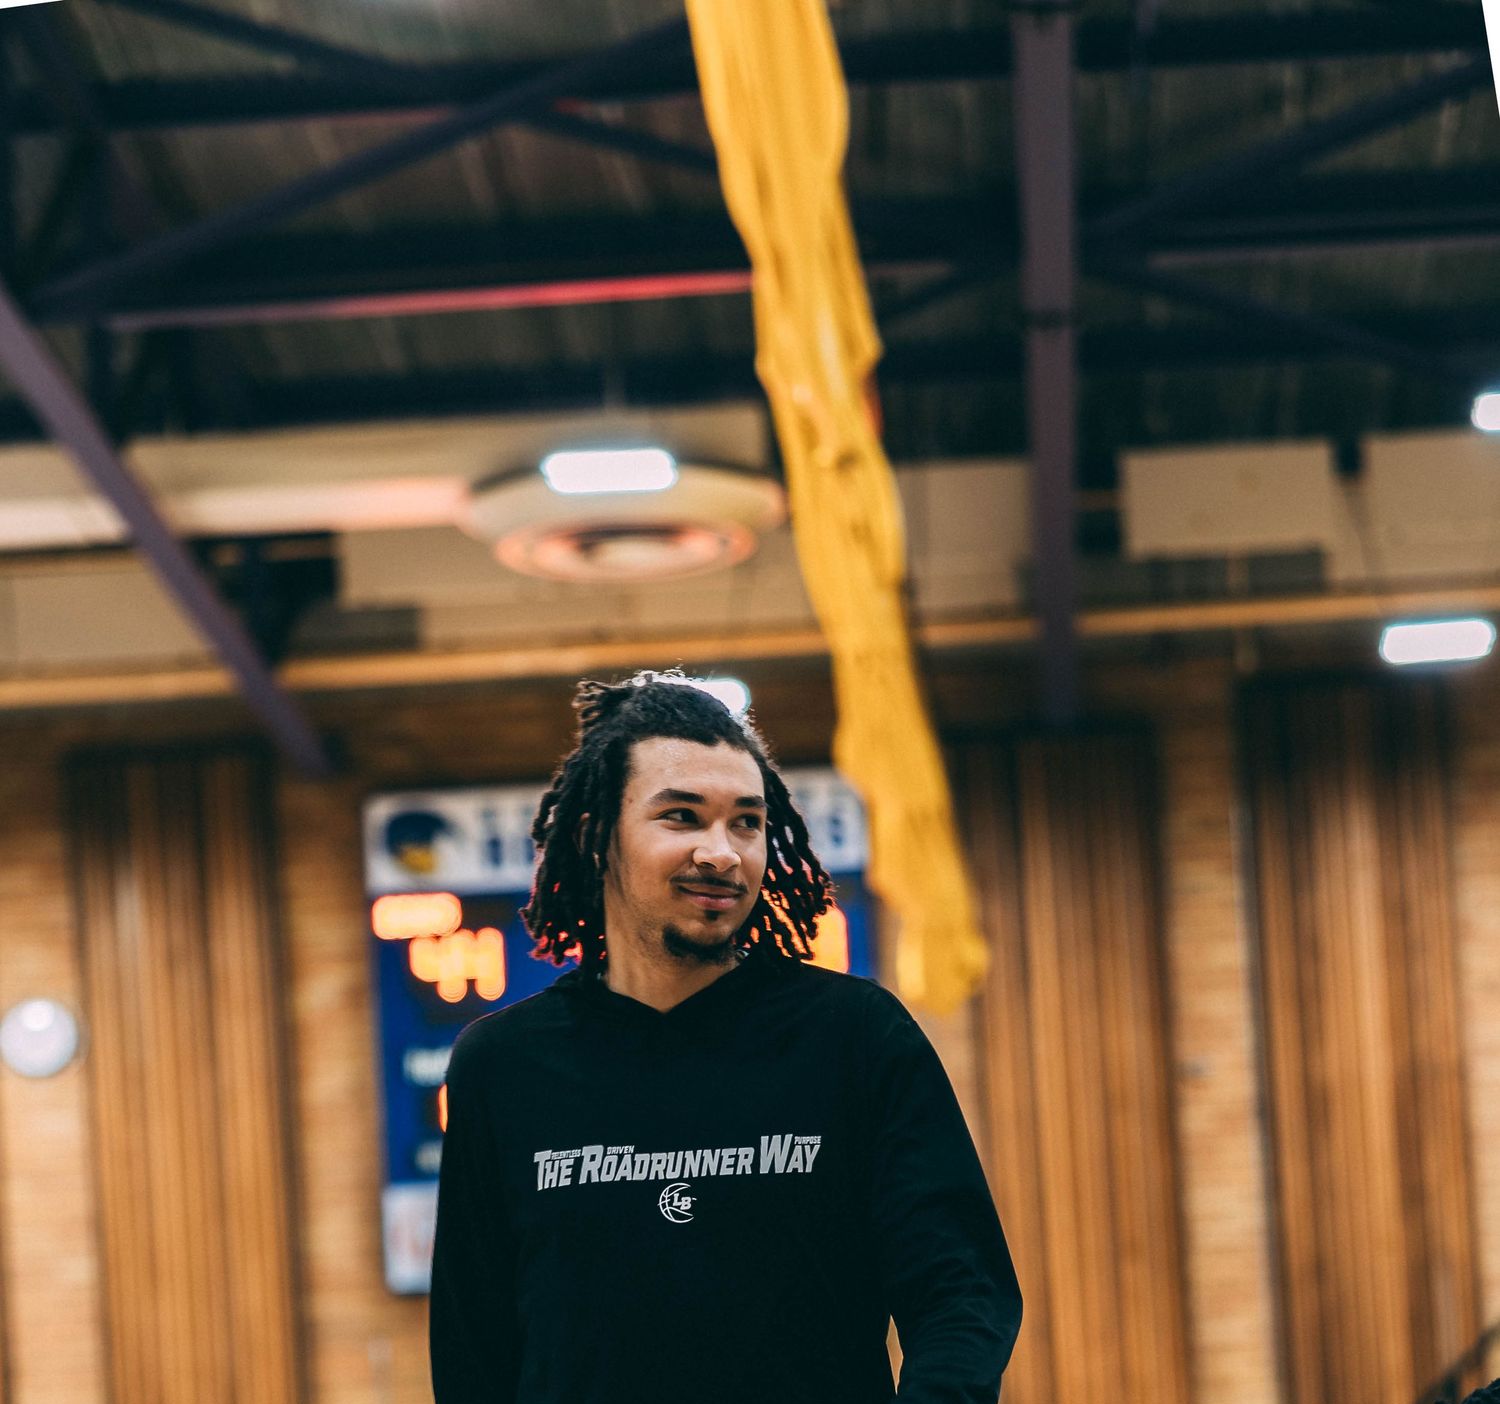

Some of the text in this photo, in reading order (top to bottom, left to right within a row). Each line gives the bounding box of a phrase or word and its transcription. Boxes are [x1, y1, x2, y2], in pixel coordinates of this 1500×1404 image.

[793, 1135, 822, 1145] PURPOSE
[550, 1148, 582, 1160] RELENTLESS
[606, 1144, 635, 1155] DRIVEN
[578, 1144, 755, 1185] ROADRUNNER
